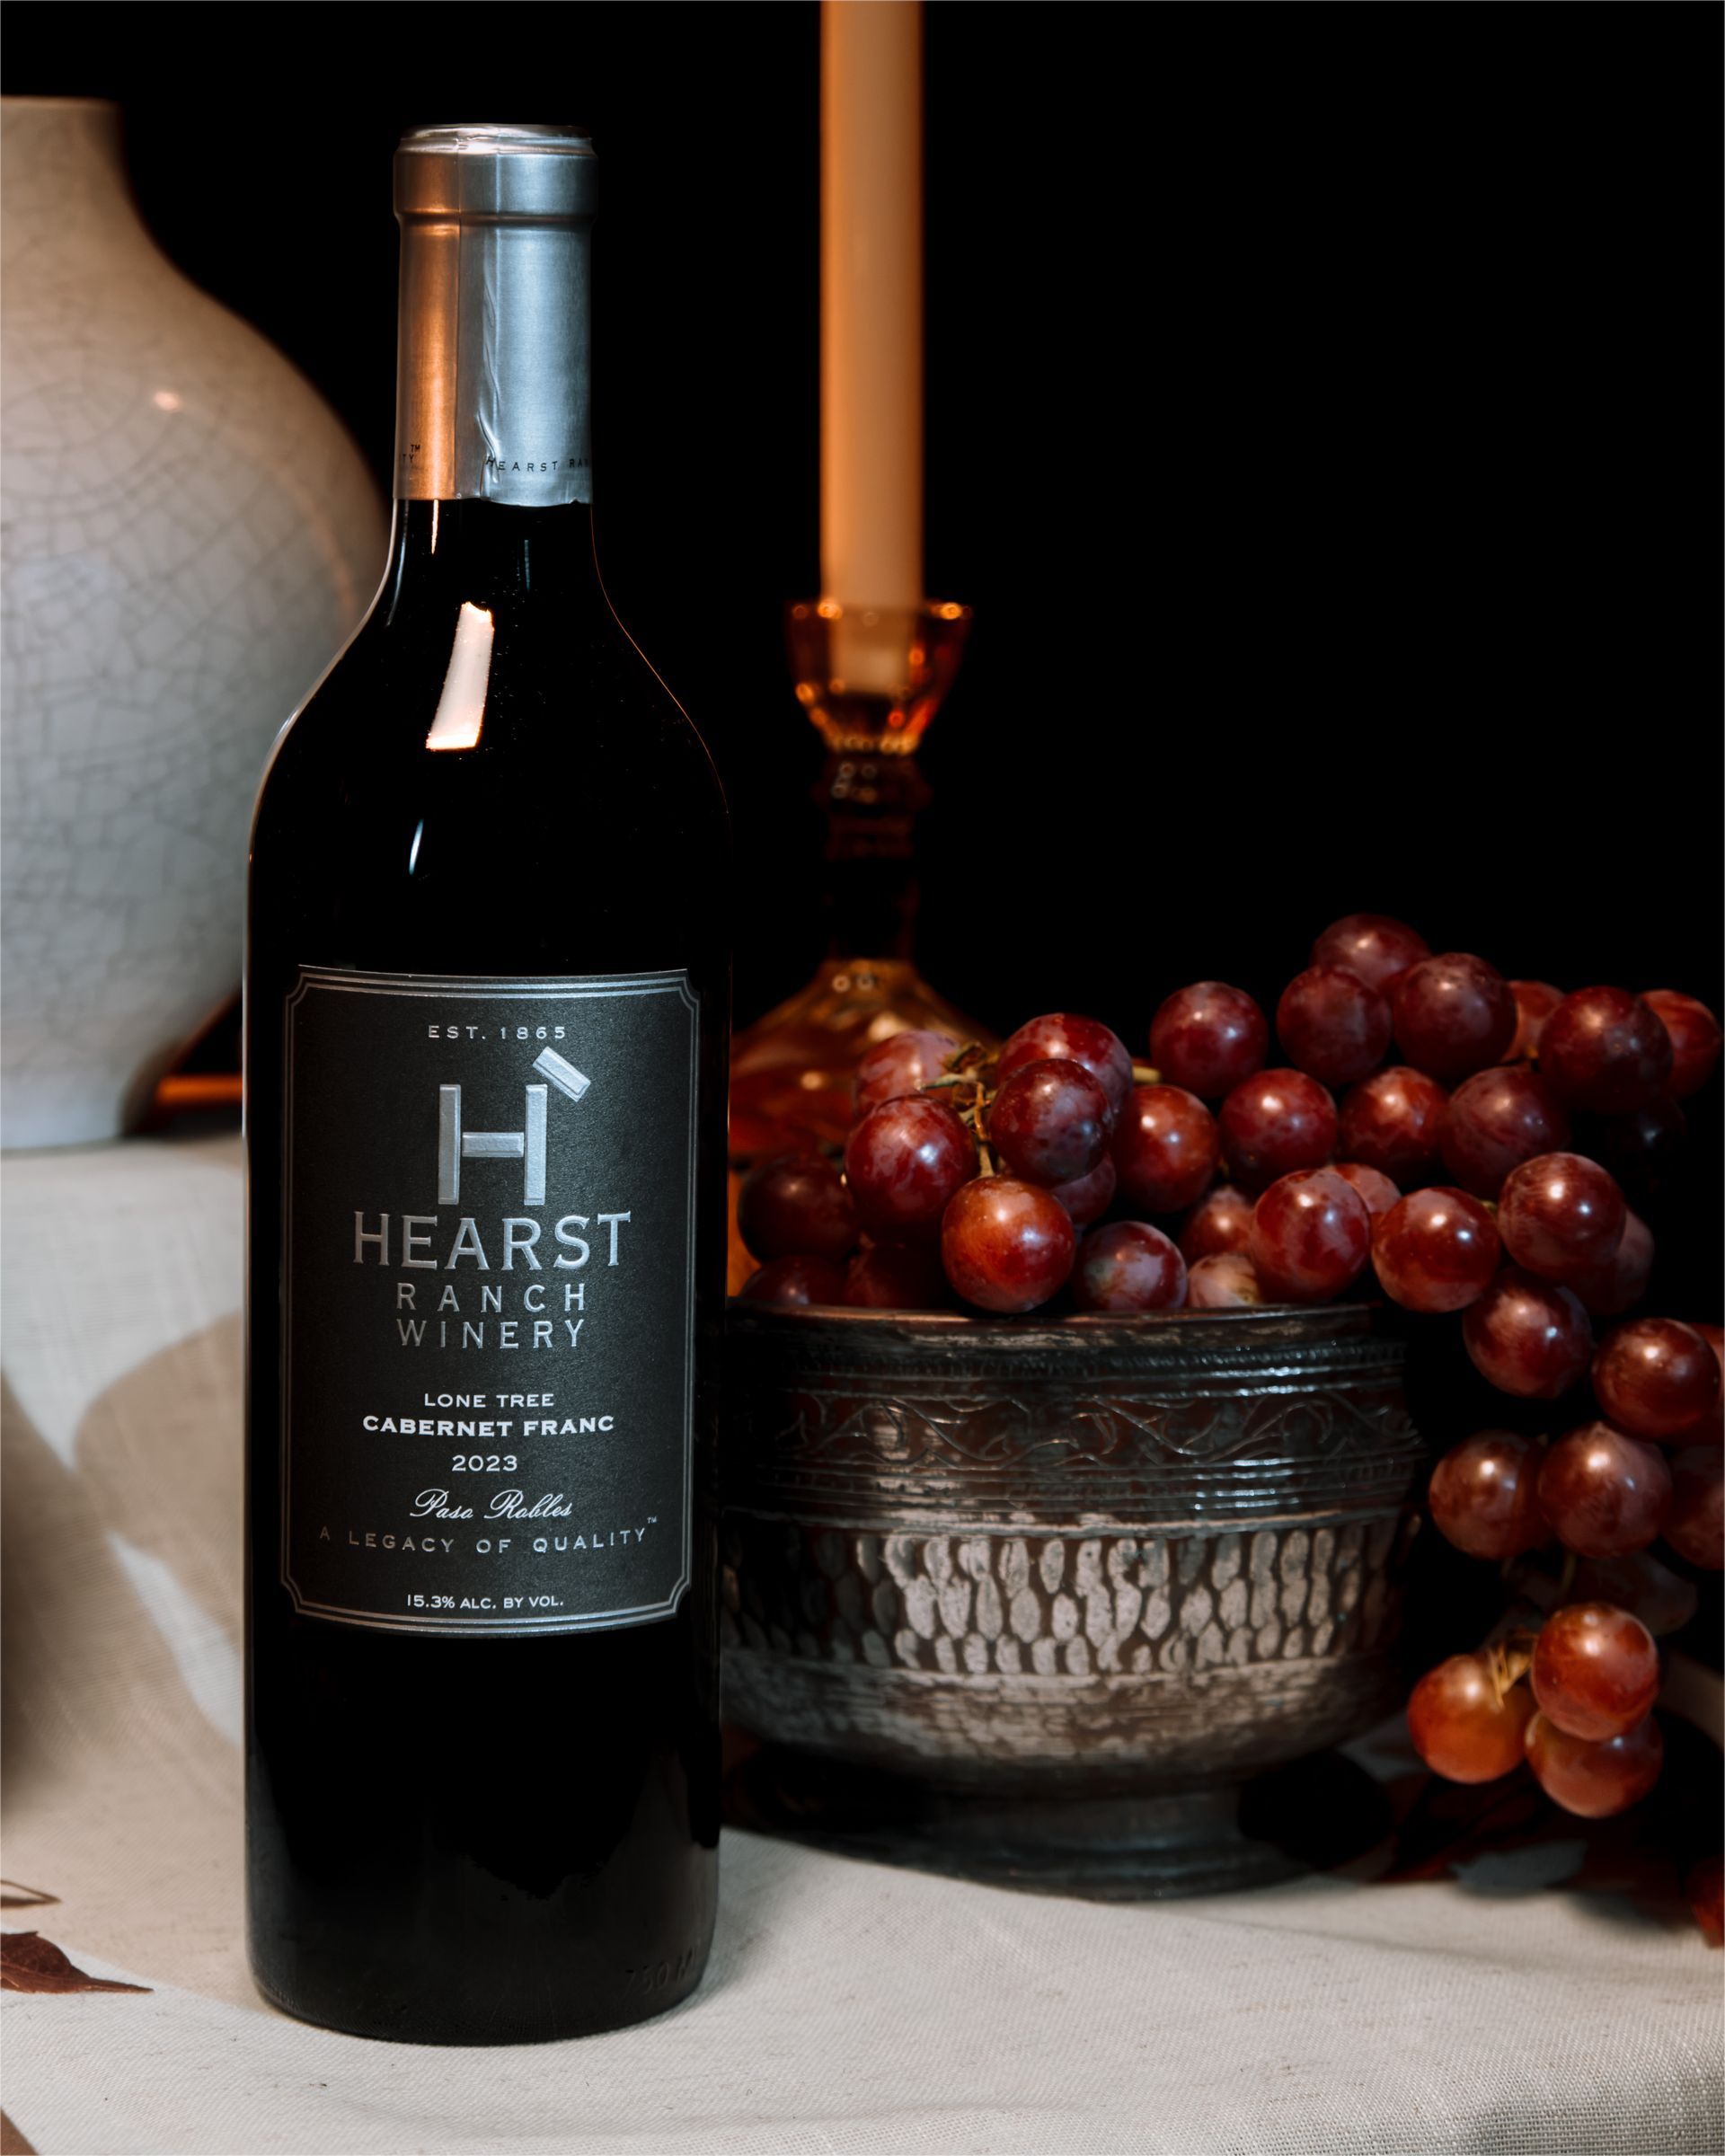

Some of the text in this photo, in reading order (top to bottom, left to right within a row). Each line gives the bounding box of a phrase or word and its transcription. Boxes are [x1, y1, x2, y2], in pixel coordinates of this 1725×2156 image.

[485, 455, 559, 472] HEARST
[428, 1025, 567, 1039] EST. 1865
[353, 1210, 632, 1271] HEARST
[395, 1282, 586, 1313] RANCH
[395, 1318, 585, 1349] WINERY
[423, 1392, 555, 1408] LONE TREE
[362, 1415, 615, 1437] CABERNET FRANC
[451, 1454, 518, 1472] 2023
[409, 1488, 573, 1520] Paso Robles
[319, 1525, 331, 1541] A
[348, 1532, 455, 1553] LEGACY
[475, 1538, 512, 1554] OF
[406, 1594, 564, 1610] 15.3% ALC. BY VOL.
